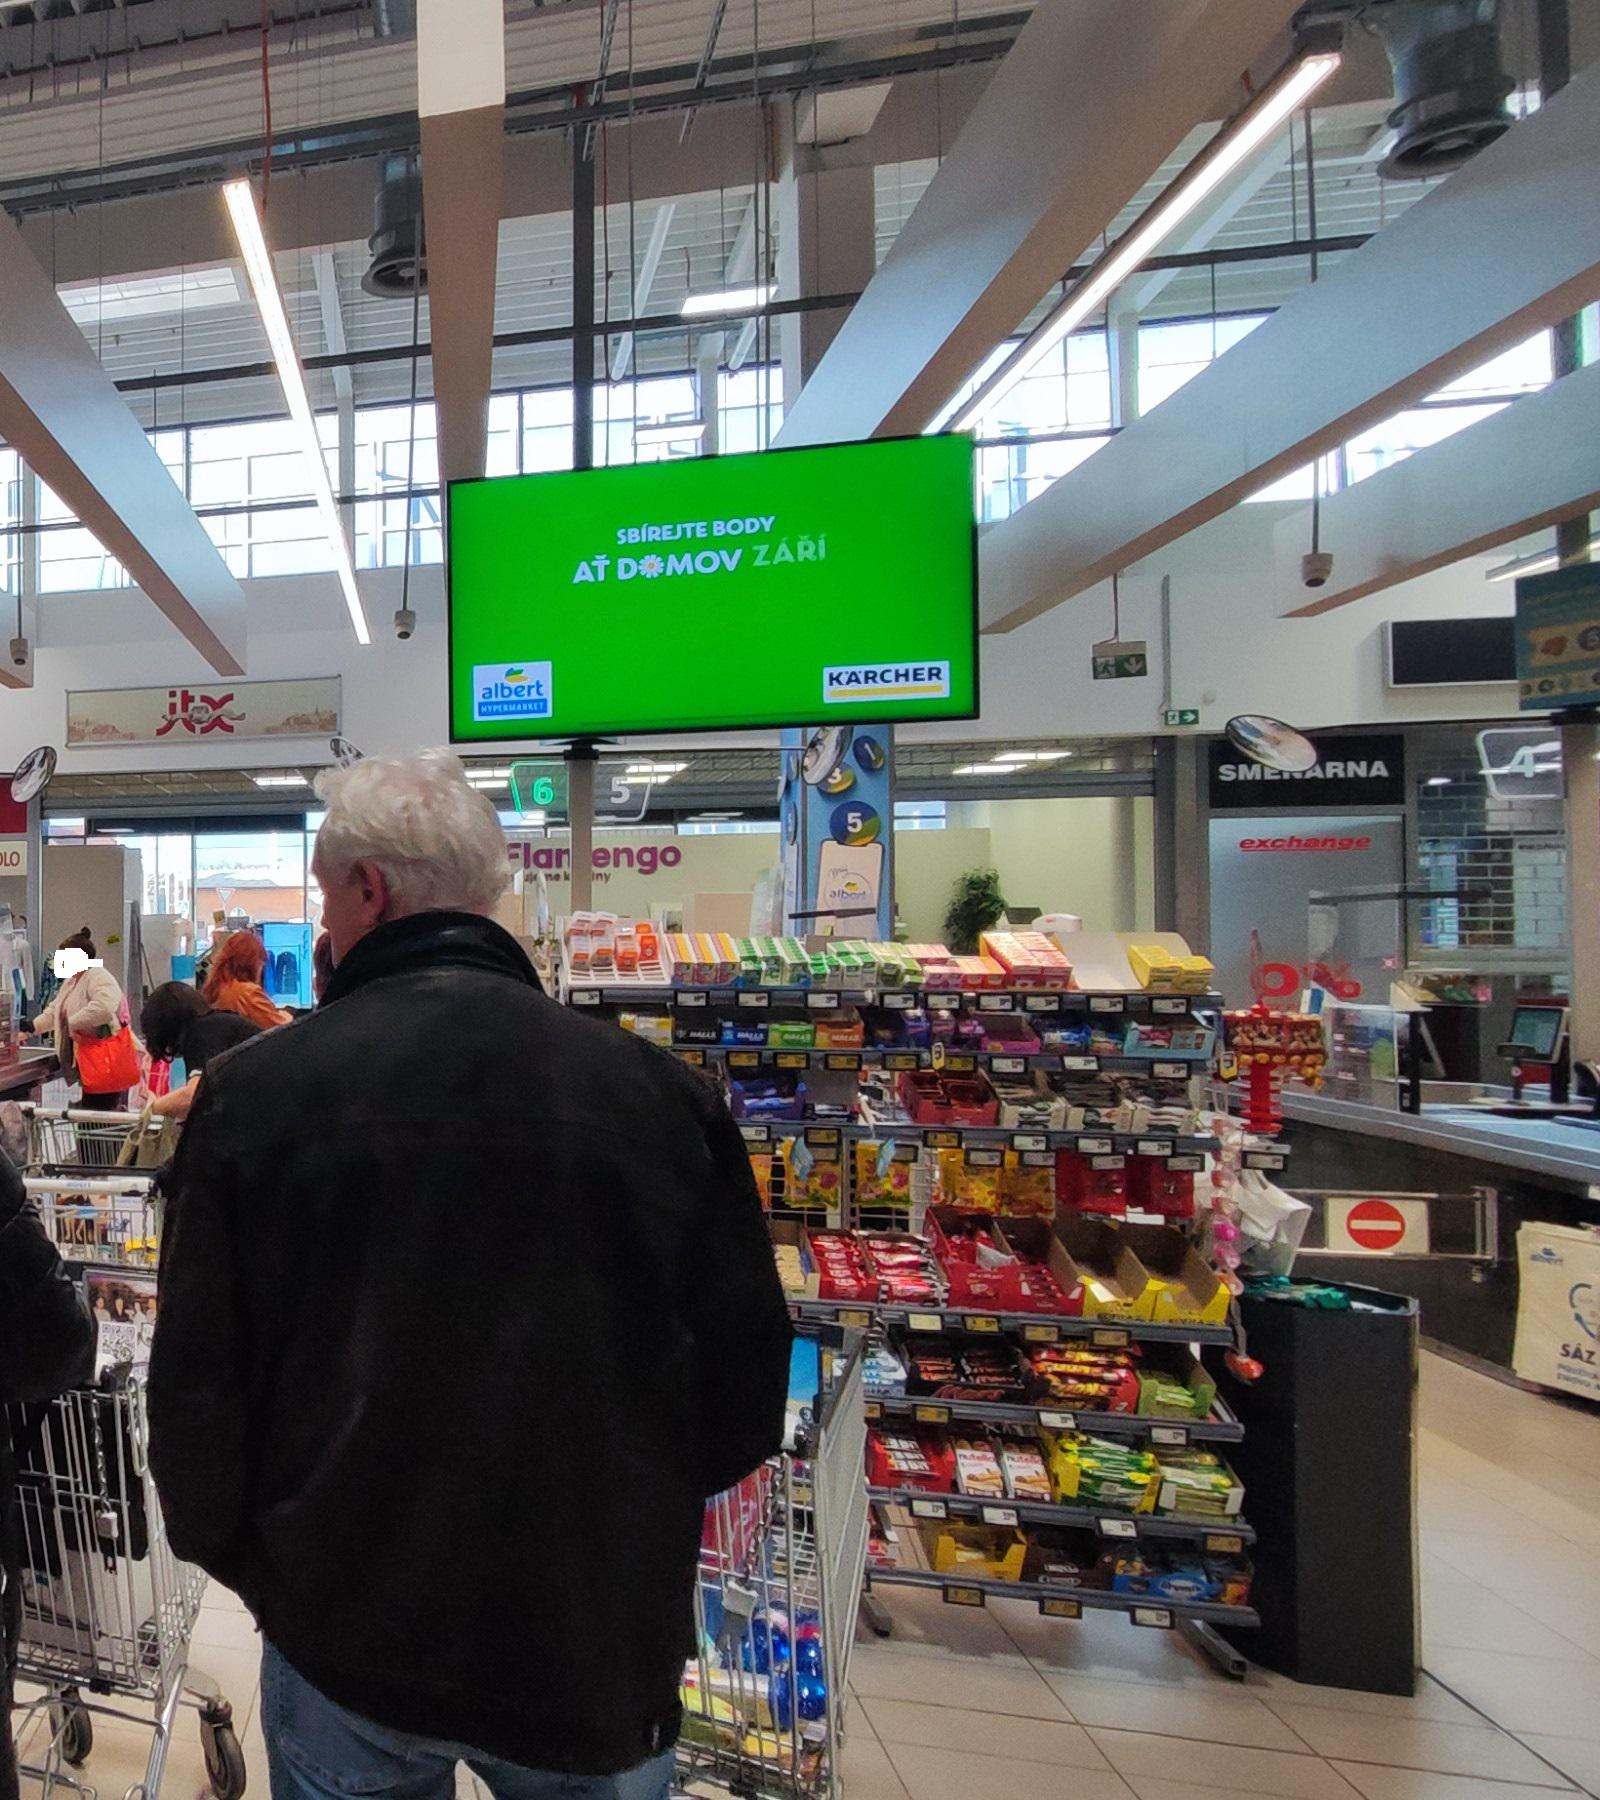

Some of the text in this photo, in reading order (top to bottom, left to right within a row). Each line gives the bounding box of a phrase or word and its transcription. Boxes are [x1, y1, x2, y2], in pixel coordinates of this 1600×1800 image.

[617, 516, 775, 545] SBÍREJTE BODY
[572, 533, 827, 584] AŤ DOMOV ZÁŘÍ
[828, 666, 943, 686] KÄRCHER
[481, 680, 544, 700] albert
[481, 702, 545, 713] HYPERMARKET
[864, 743, 876, 760] 1
[1507, 746, 1535, 778] 4
[827, 768, 842, 783] 3
[532, 776, 554, 805] 6
[610, 777, 631, 804] 5
[846, 812, 863, 833] 5
[1239, 835, 1372, 850] exchange
